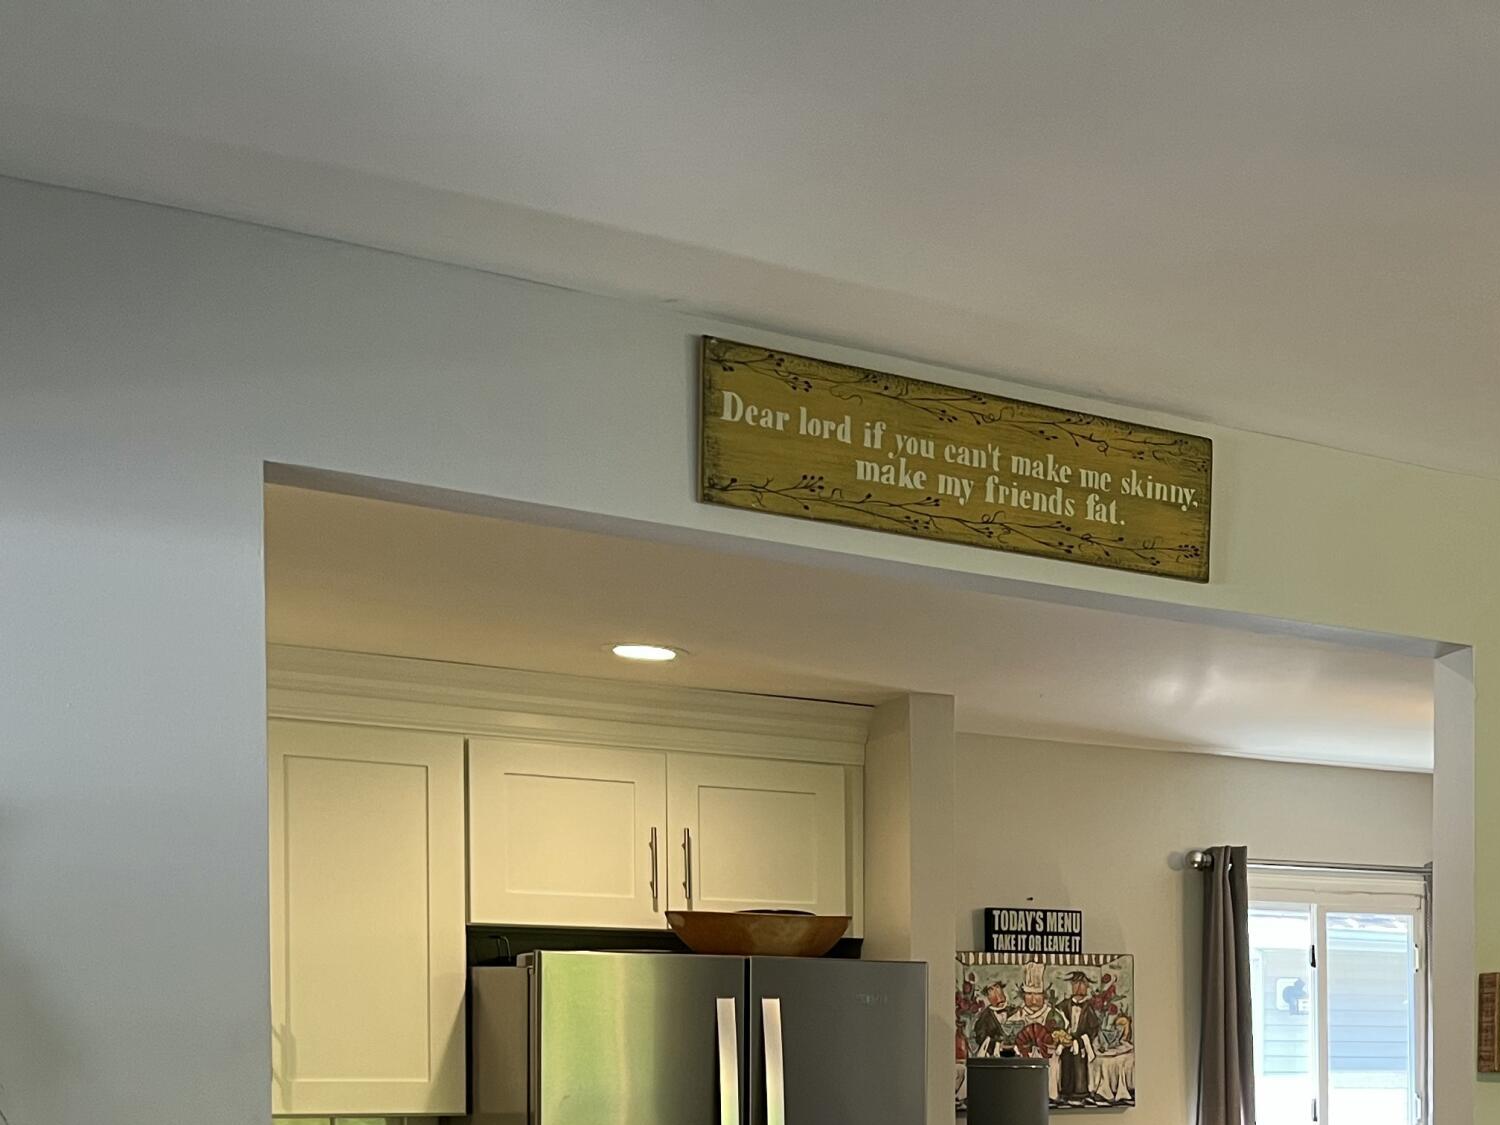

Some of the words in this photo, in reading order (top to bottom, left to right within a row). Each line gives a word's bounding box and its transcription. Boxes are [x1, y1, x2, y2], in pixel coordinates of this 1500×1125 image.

[719, 390, 790, 432] Dear
[799, 406, 851, 444] lord
[863, 421, 886, 449] if
[888, 434, 935, 459] you
[944, 443, 1001, 472] can't
[1011, 454, 1072, 484] make
[1079, 468, 1112, 492] me
[1121, 469, 1199, 512] skinny,
[855, 457, 927, 490] make
[937, 474, 974, 506] my
[984, 475, 1075, 517] friends
[1084, 493, 1126, 526] fat.
[992, 909, 1044, 932] TODAY'S
[1046, 911, 1080, 933] MENU
[992, 933, 1016, 951] TAKE
[1017, 934, 1027, 951] IT
[1028, 934, 1042, 952] OR
[1043, 935, 1070, 952] LEAVE
[1071, 936, 1080, 953] IT
